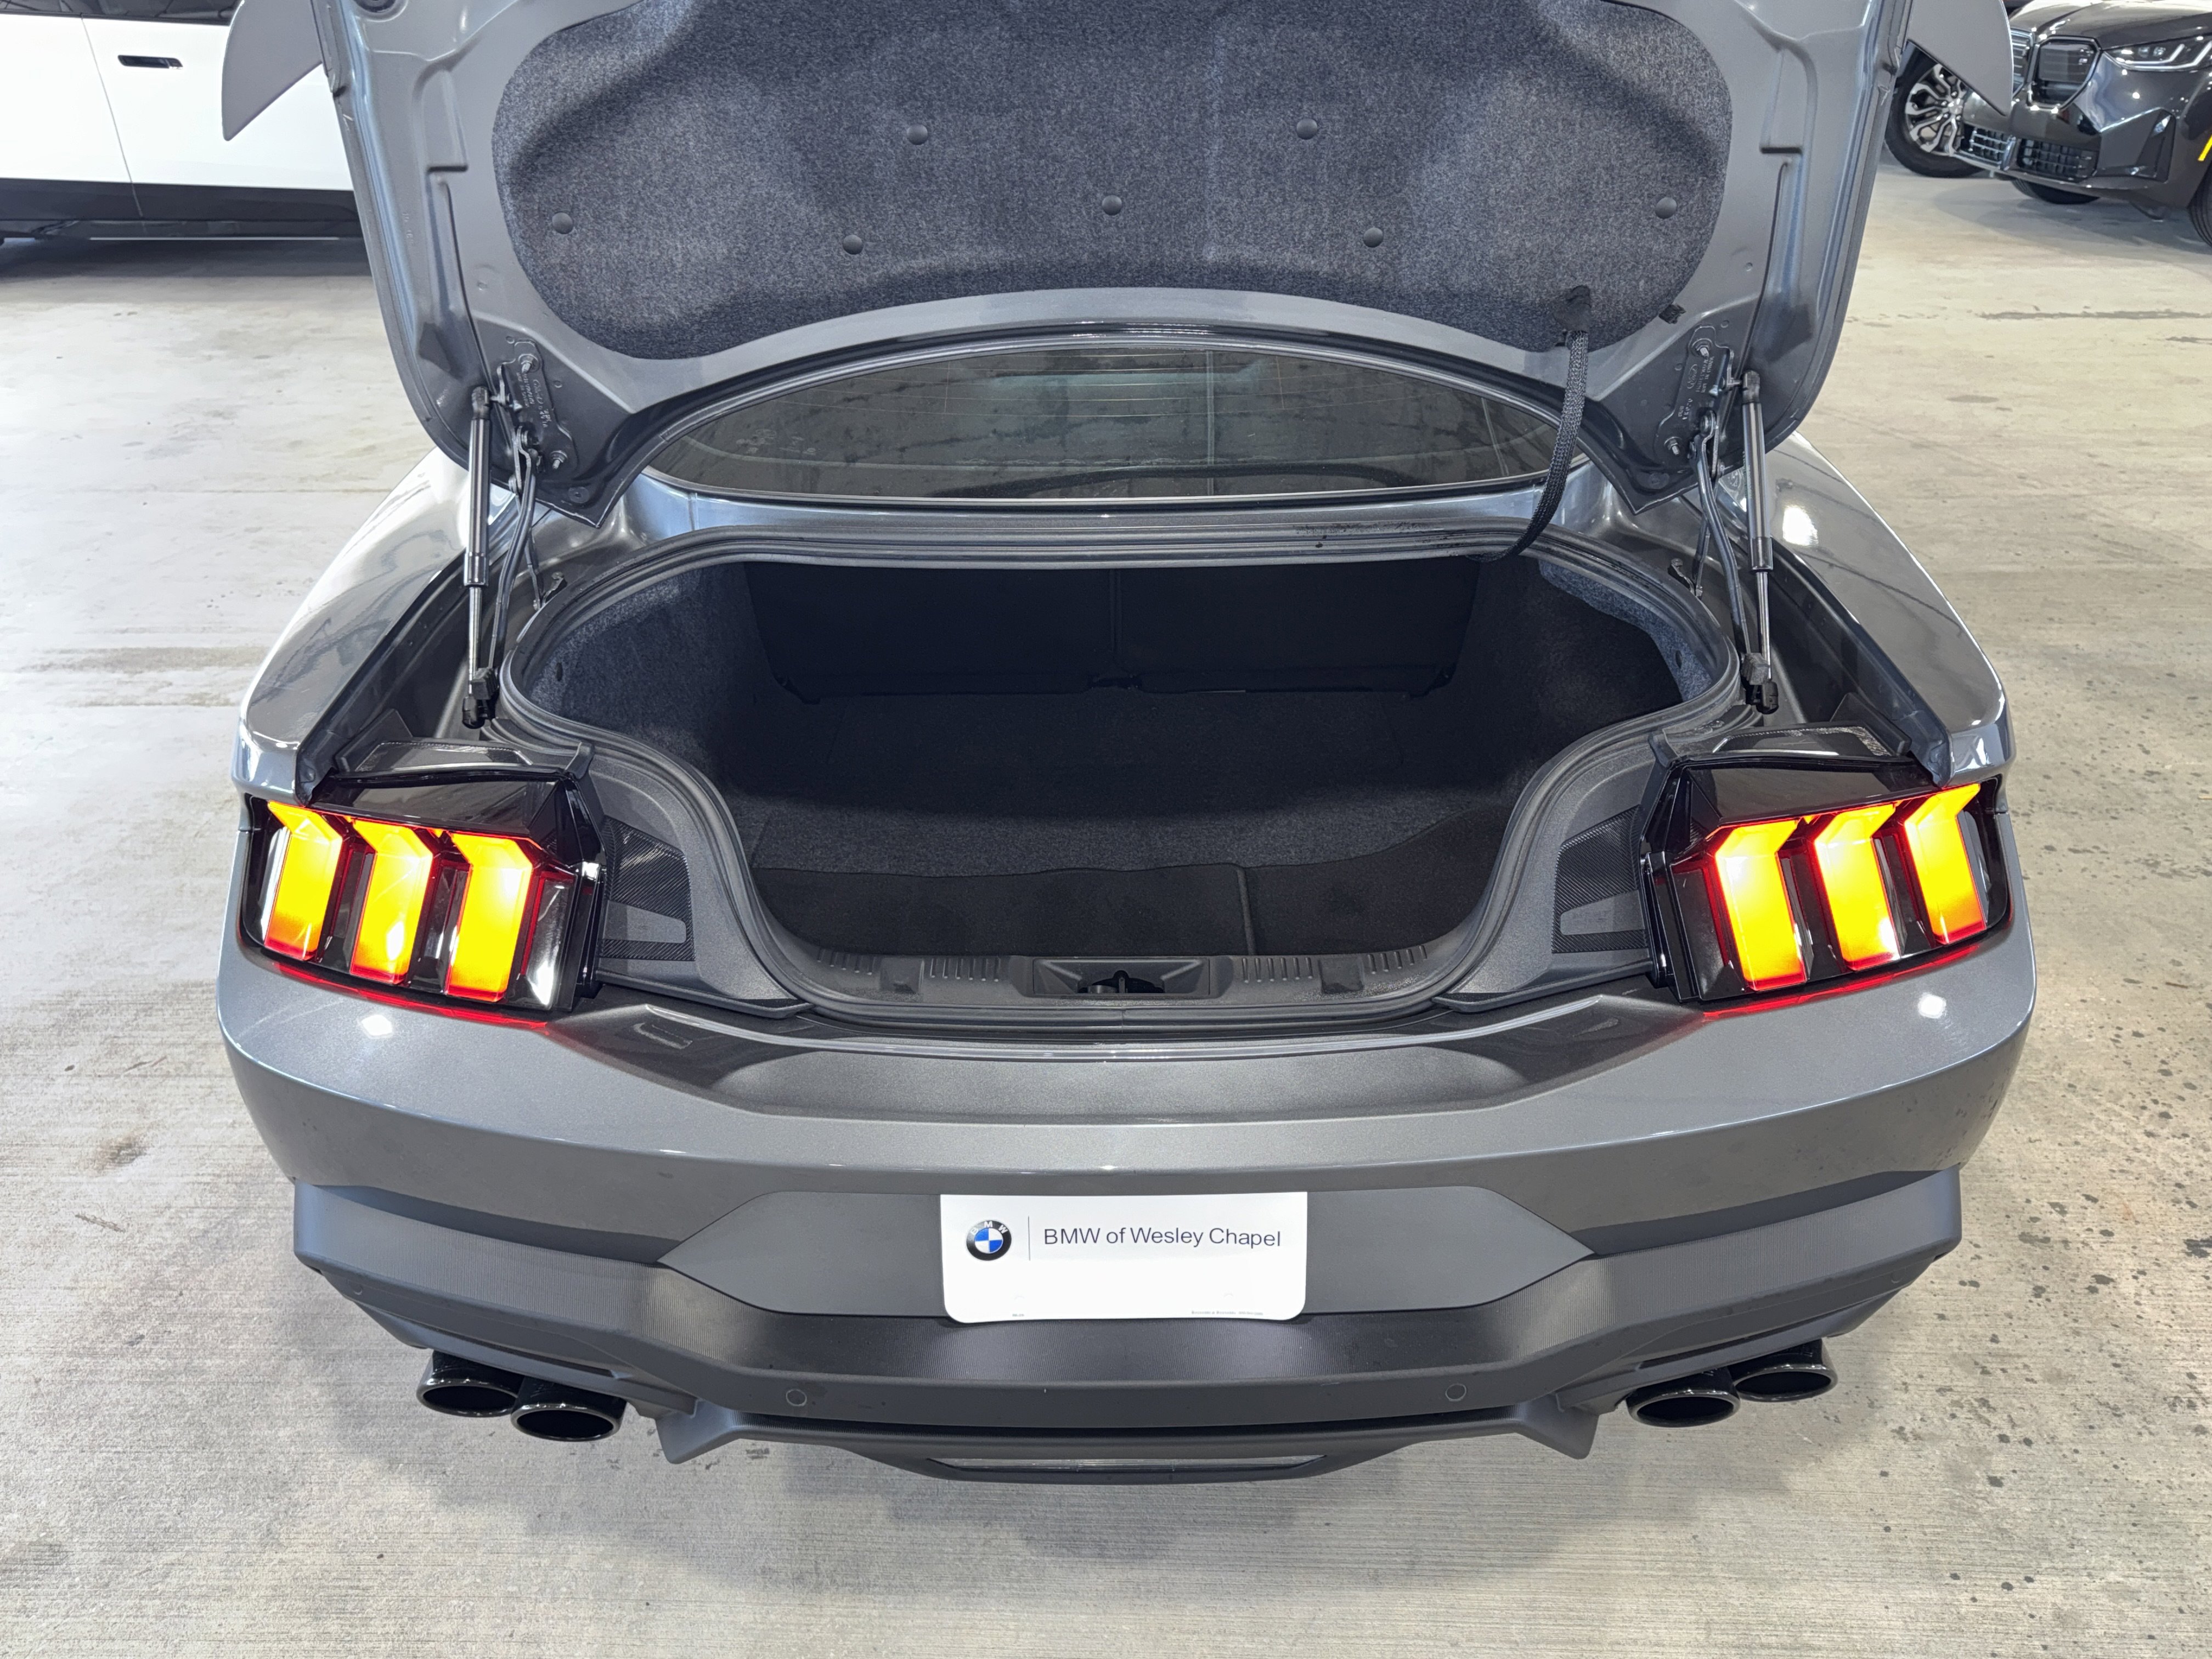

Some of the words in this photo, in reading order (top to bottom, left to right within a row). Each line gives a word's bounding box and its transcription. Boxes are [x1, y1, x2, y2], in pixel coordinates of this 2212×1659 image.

[970, 1221, 1008, 1235] BMW
[1044, 1227, 1101, 1245] BMW
[1106, 1227, 1126, 1244] of
[1130, 1227, 1204, 1248] Wesley
[1209, 1227, 1280, 1249] Chapel
